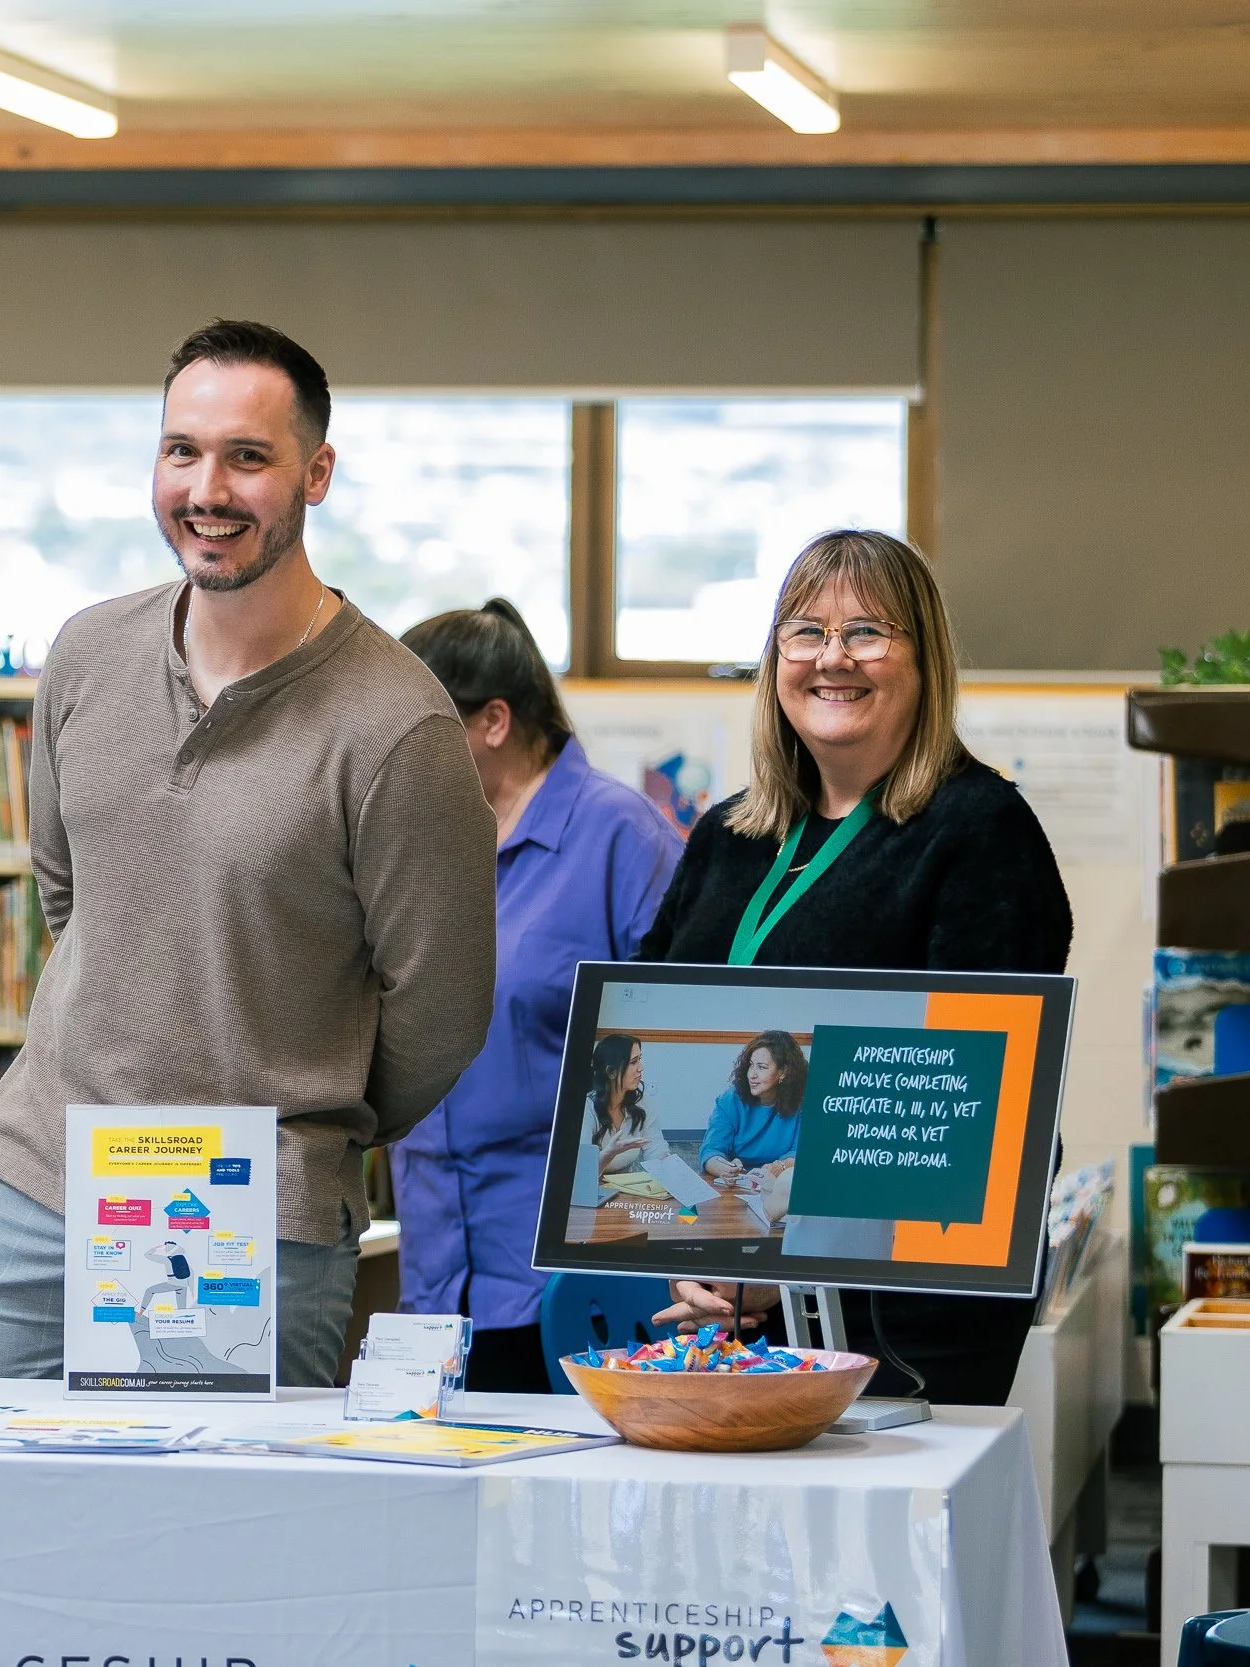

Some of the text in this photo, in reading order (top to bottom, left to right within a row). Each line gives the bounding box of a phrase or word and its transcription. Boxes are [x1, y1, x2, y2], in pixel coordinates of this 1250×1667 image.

[853, 1046, 955, 1066] APPRENTICESHIPS
[838, 1071, 968, 1092] INVOLVE COMPLETING
[822, 1095, 982, 1119] CERTIFICATE II, III, IV, VET
[138, 1136, 203, 1144] SKILLSROAD
[847, 1124, 950, 1142] DIPLOMA OR VET
[109, 1146, 203, 1154] CAREER JOURNEY
[831, 1148, 952, 1168] ADVANCED DIPLOMA.
[604, 1201, 668, 1211] APPRENTICESHIP
[629, 1207, 675, 1224] support
[80, 1377, 146, 1388] SKILLSROAD.COM.AU
[508, 1598, 775, 1628] APPRENTICESHIP
[615, 1616, 805, 1667] support
